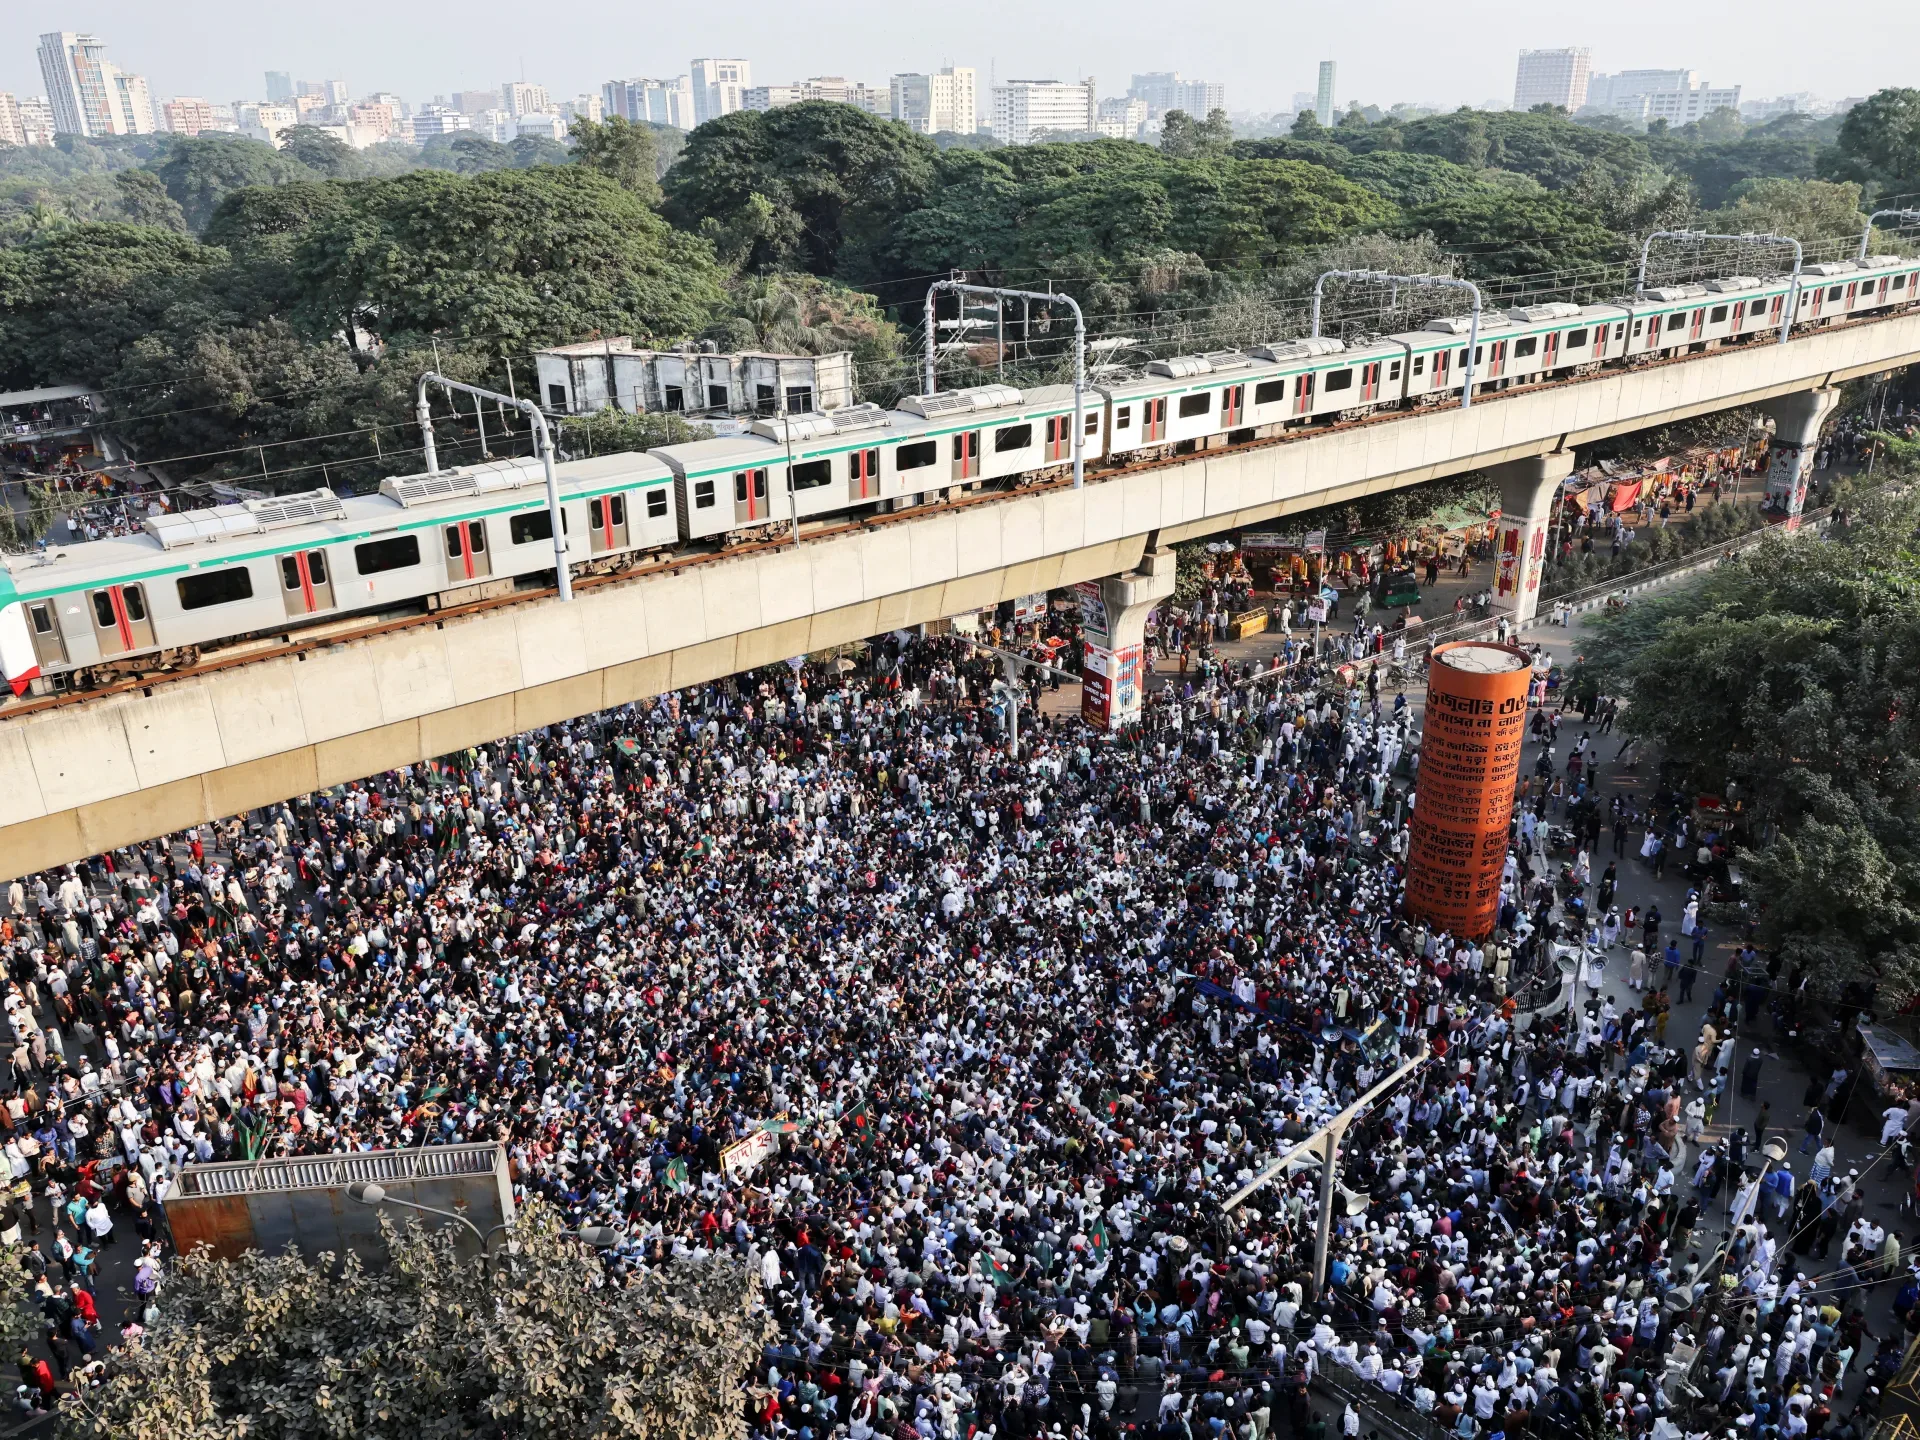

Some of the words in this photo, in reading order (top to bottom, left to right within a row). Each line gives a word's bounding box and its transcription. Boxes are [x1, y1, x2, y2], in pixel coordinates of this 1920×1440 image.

[1440, 692, 1494, 715] জুলাই
[1477, 719, 1492, 728] না
[1443, 725, 1491, 738] বাংলাদেশ
[1430, 832, 1474, 849] মহাজন
